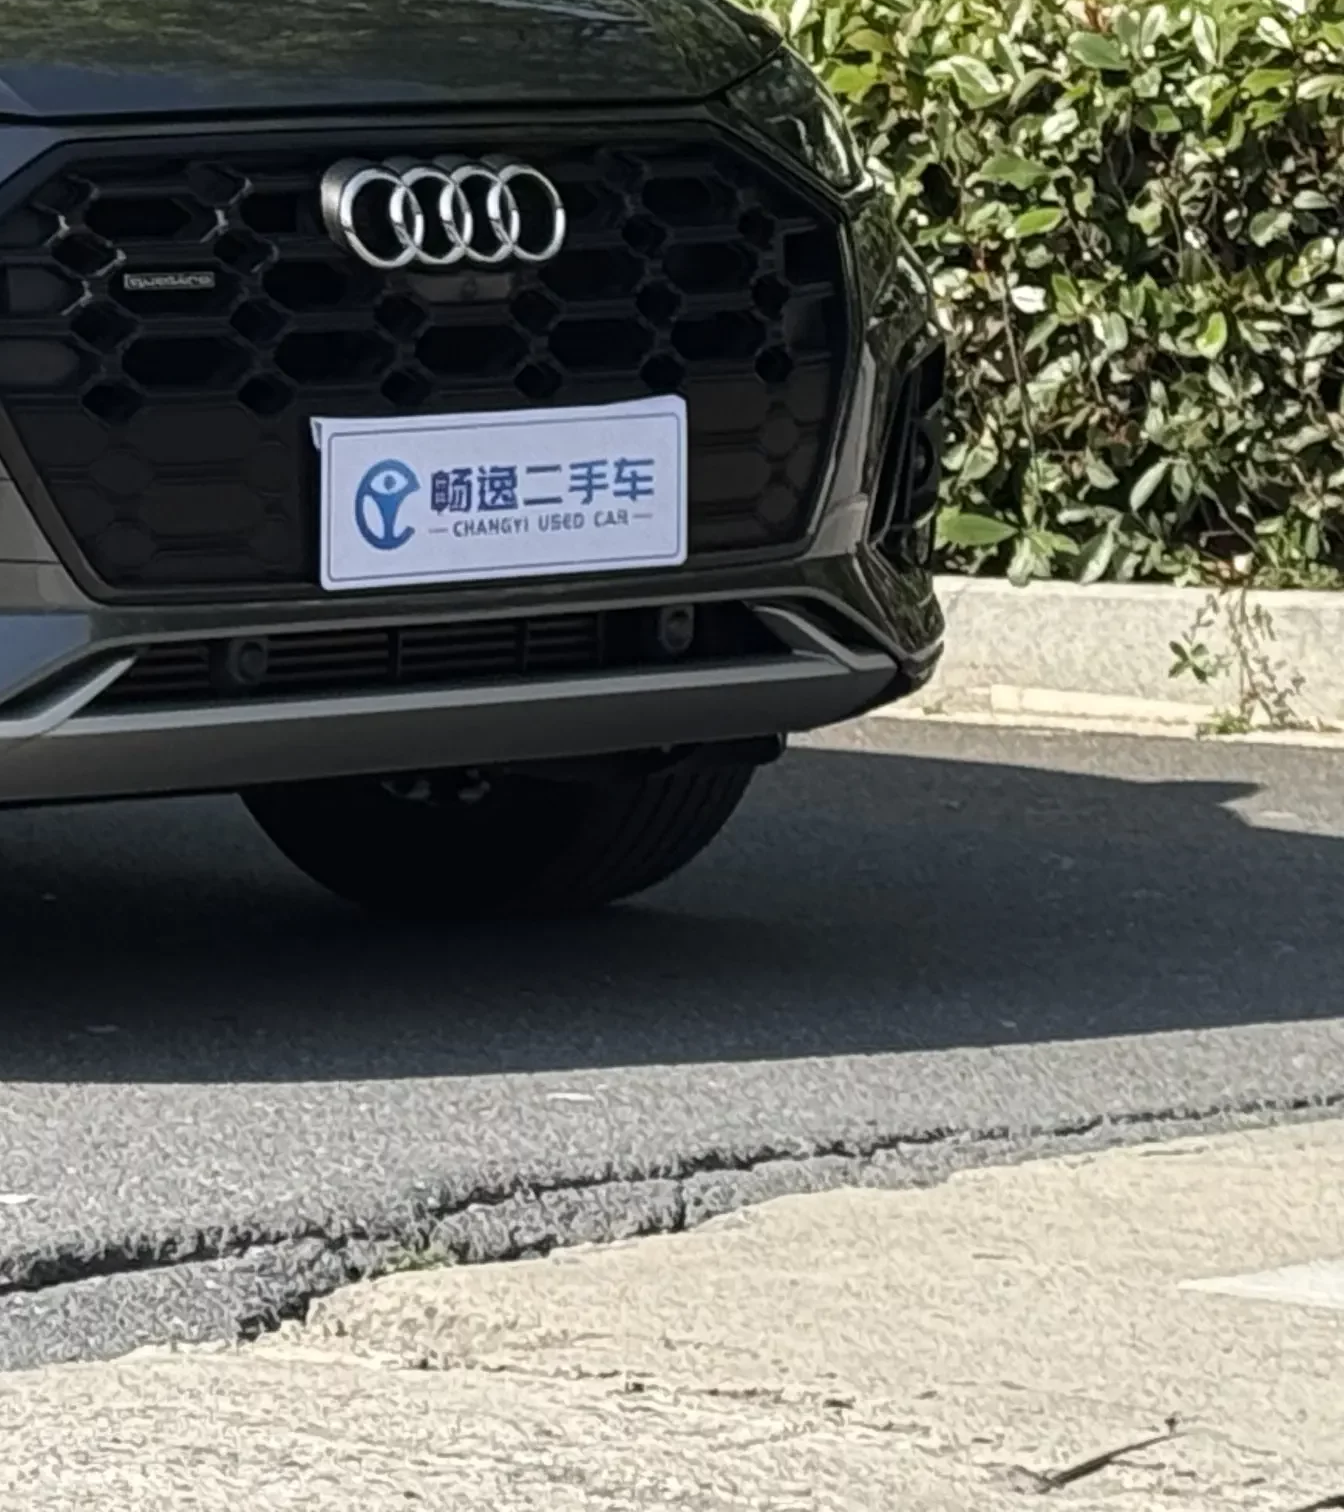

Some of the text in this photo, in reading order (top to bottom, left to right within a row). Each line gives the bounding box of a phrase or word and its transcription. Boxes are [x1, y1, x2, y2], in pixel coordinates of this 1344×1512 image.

[430, 457, 655, 515] 畅逸二手车
[452, 508, 629, 538] CHANGYI USED CAR
